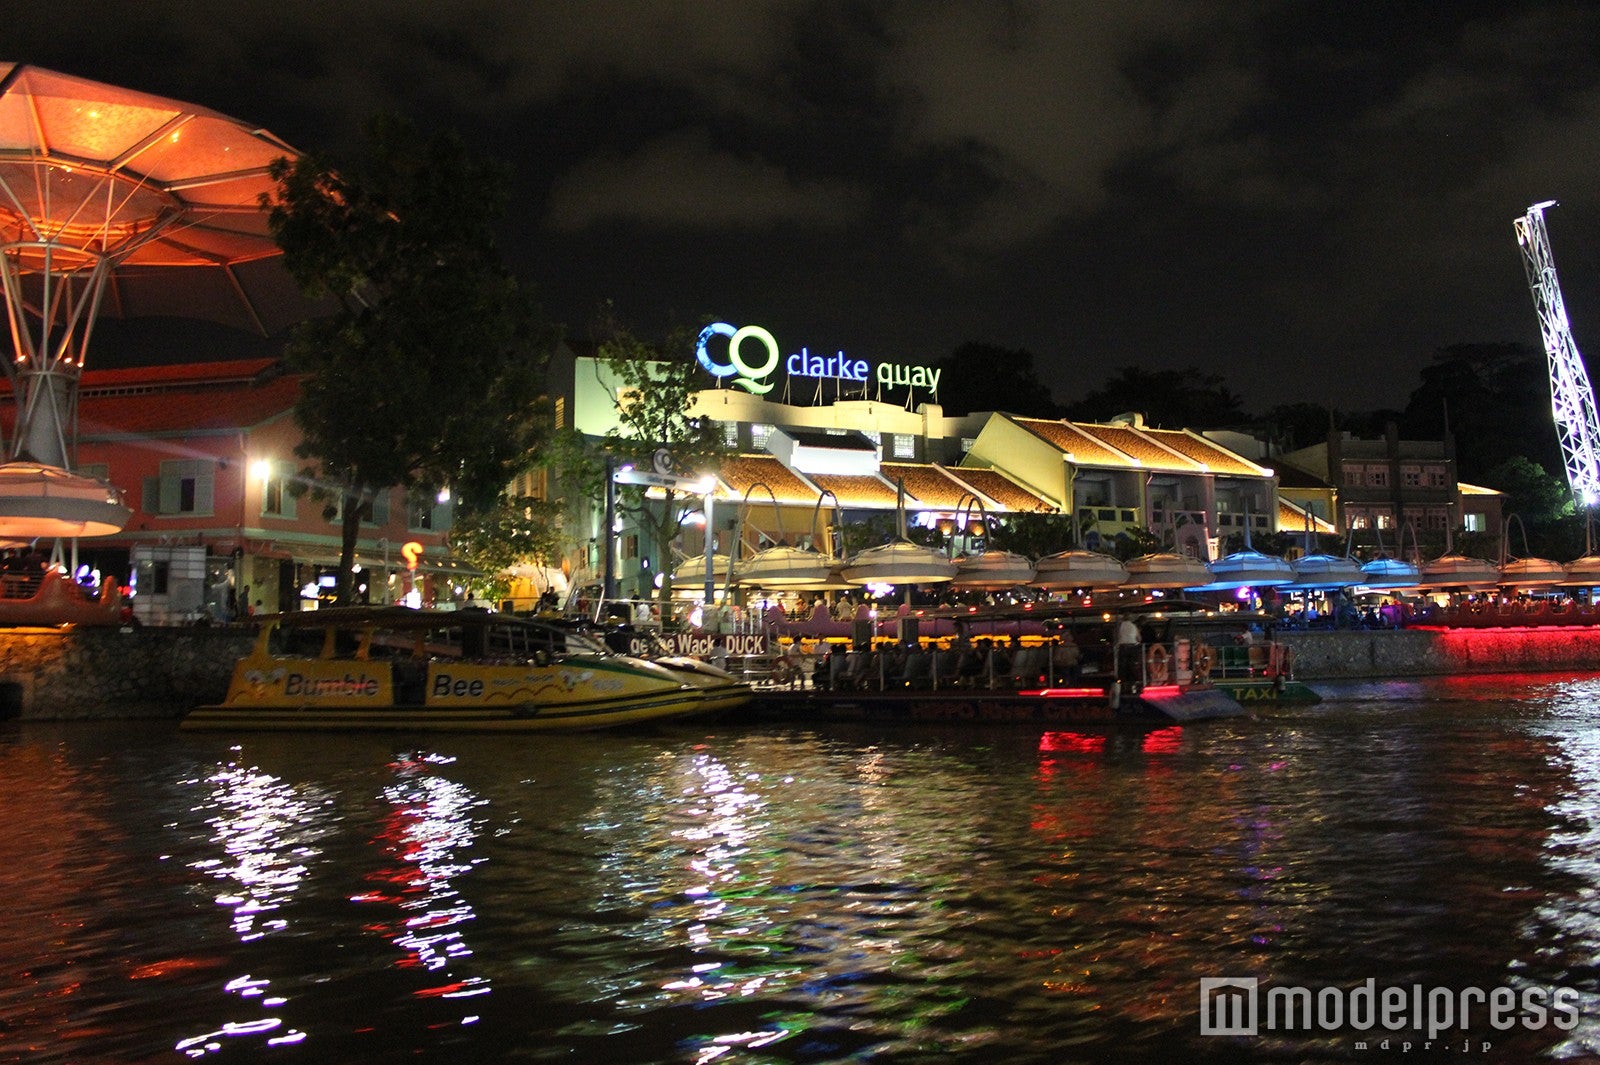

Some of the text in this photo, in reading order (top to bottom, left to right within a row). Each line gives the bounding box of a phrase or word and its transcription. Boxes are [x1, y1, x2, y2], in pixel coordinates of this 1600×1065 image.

[787, 347, 869, 381] clarke
[877, 362, 941, 394] quay
[726, 635, 764, 654] DUCK
[284, 673, 484, 697] Bumble Bee
[1232, 688, 1278, 700] TAXI
